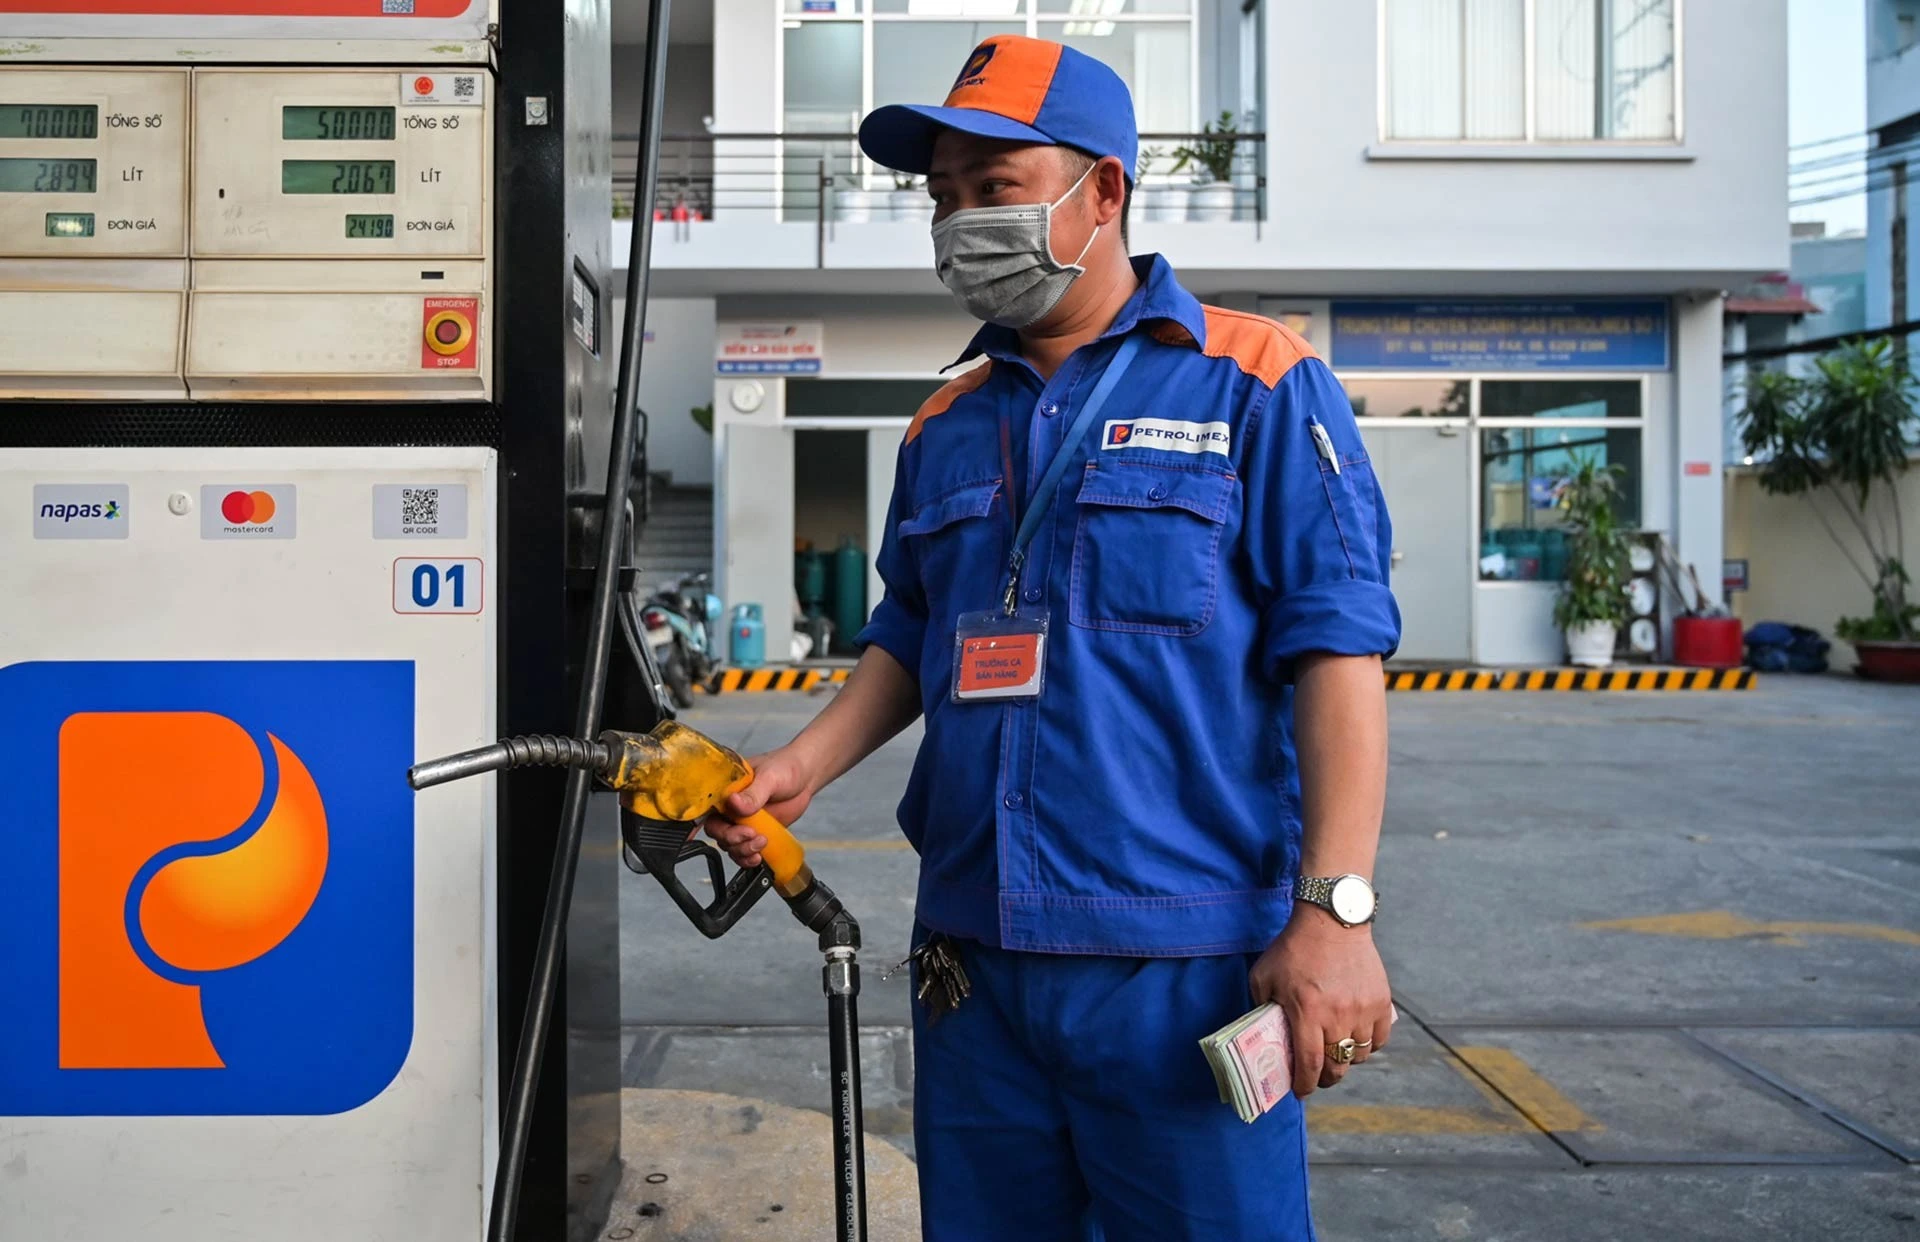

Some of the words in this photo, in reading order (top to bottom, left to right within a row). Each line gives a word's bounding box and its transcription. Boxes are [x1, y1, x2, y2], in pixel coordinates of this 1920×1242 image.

[21, 109, 94, 138] 70000
[106, 113, 140, 128] TỔNG
[145, 114, 162, 128] SỐ
[318, 111, 391, 139] 50000
[403, 115, 437, 129] TỔNG
[442, 115, 460, 129] SỐ
[35, 163, 95, 192] 2.894
[123, 167, 143, 181] LÍT
[332, 165, 391, 193] 2.067
[421, 168, 441, 182] LÍT
[108, 219, 133, 230] ĐƠN
[135, 218, 156, 230] GIÁ
[348, 218, 393, 237] 24190
[407, 220, 432, 231] ĐƠN
[434, 219, 455, 231] GIÁ
[426, 300, 476, 308] EMERGENCY
[437, 358, 460, 366] STOP
[1134, 427, 1229, 444] PETROLIMEX
[40, 504, 102, 522] napas
[412, 563, 464, 607] 01
[841, 1071, 849, 1084] SC
[842, 1089, 850, 1137] KINGFLEX
